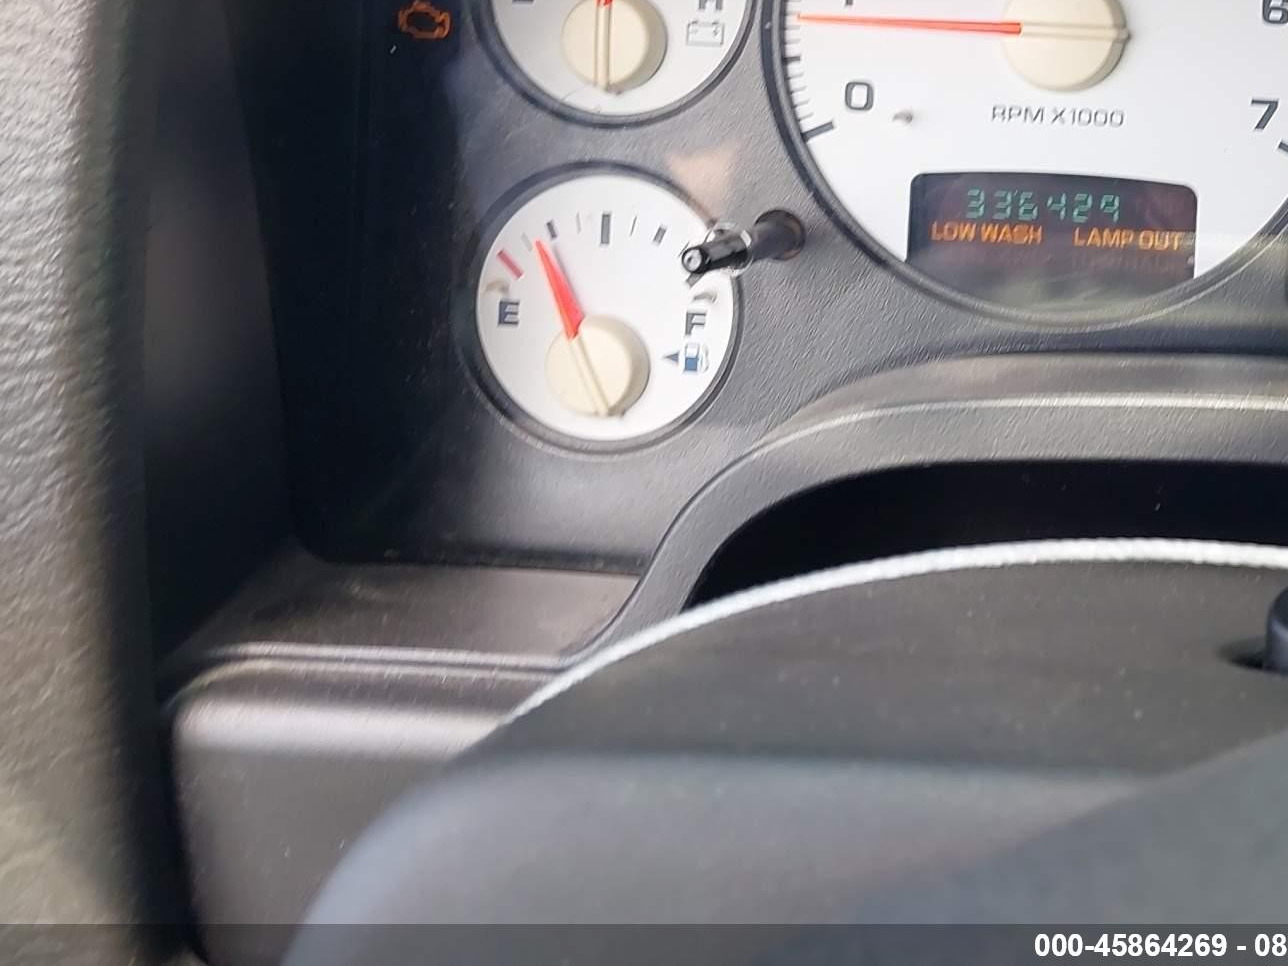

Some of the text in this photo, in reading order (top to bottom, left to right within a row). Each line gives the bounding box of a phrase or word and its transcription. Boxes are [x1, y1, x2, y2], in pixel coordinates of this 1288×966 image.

[844, 81, 874, 112] 0
[990, 104, 1125, 127] RPM X1000
[1250, 98, 1279, 131] 7
[966, 189, 1120, 223] 336429
[931, 221, 1043, 245] LOW WASH
[1073, 227, 1187, 252] LAMP OUT
[497, 299, 520, 326] E
[684, 311, 707, 336] F
